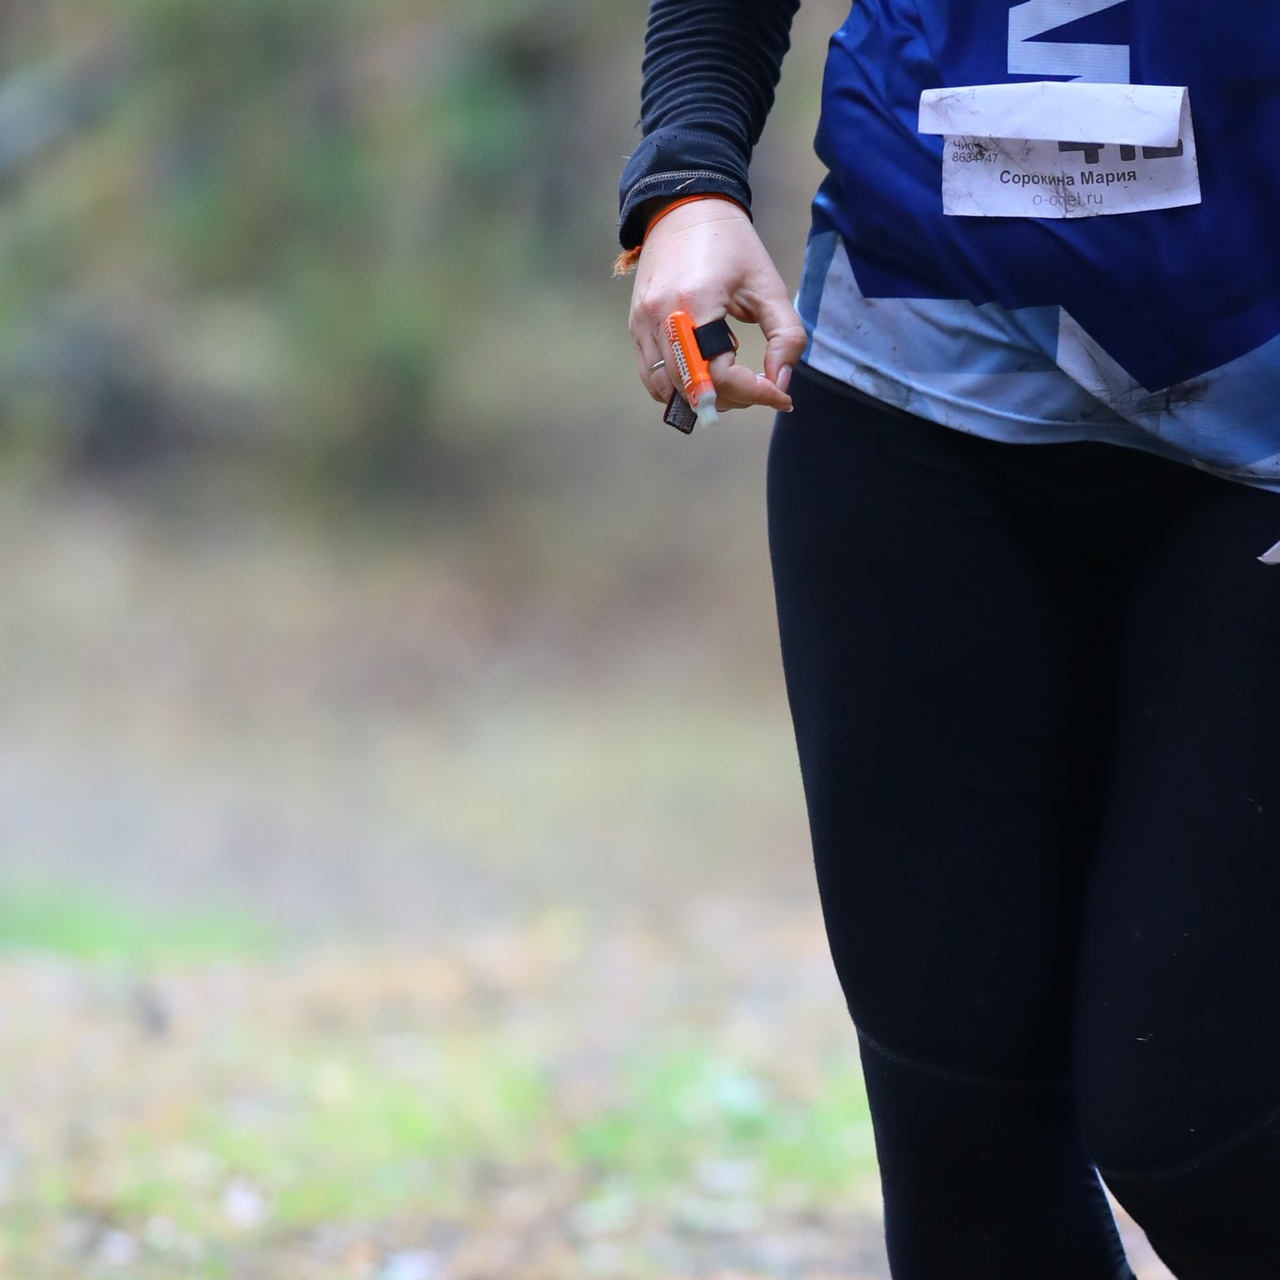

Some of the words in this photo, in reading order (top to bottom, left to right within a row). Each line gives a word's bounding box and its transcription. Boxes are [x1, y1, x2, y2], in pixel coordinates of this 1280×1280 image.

[952, 151, 998, 163] 8634747
[1000, 170, 1075, 187] Сорокина
[1080, 170, 1137, 186] Мария
